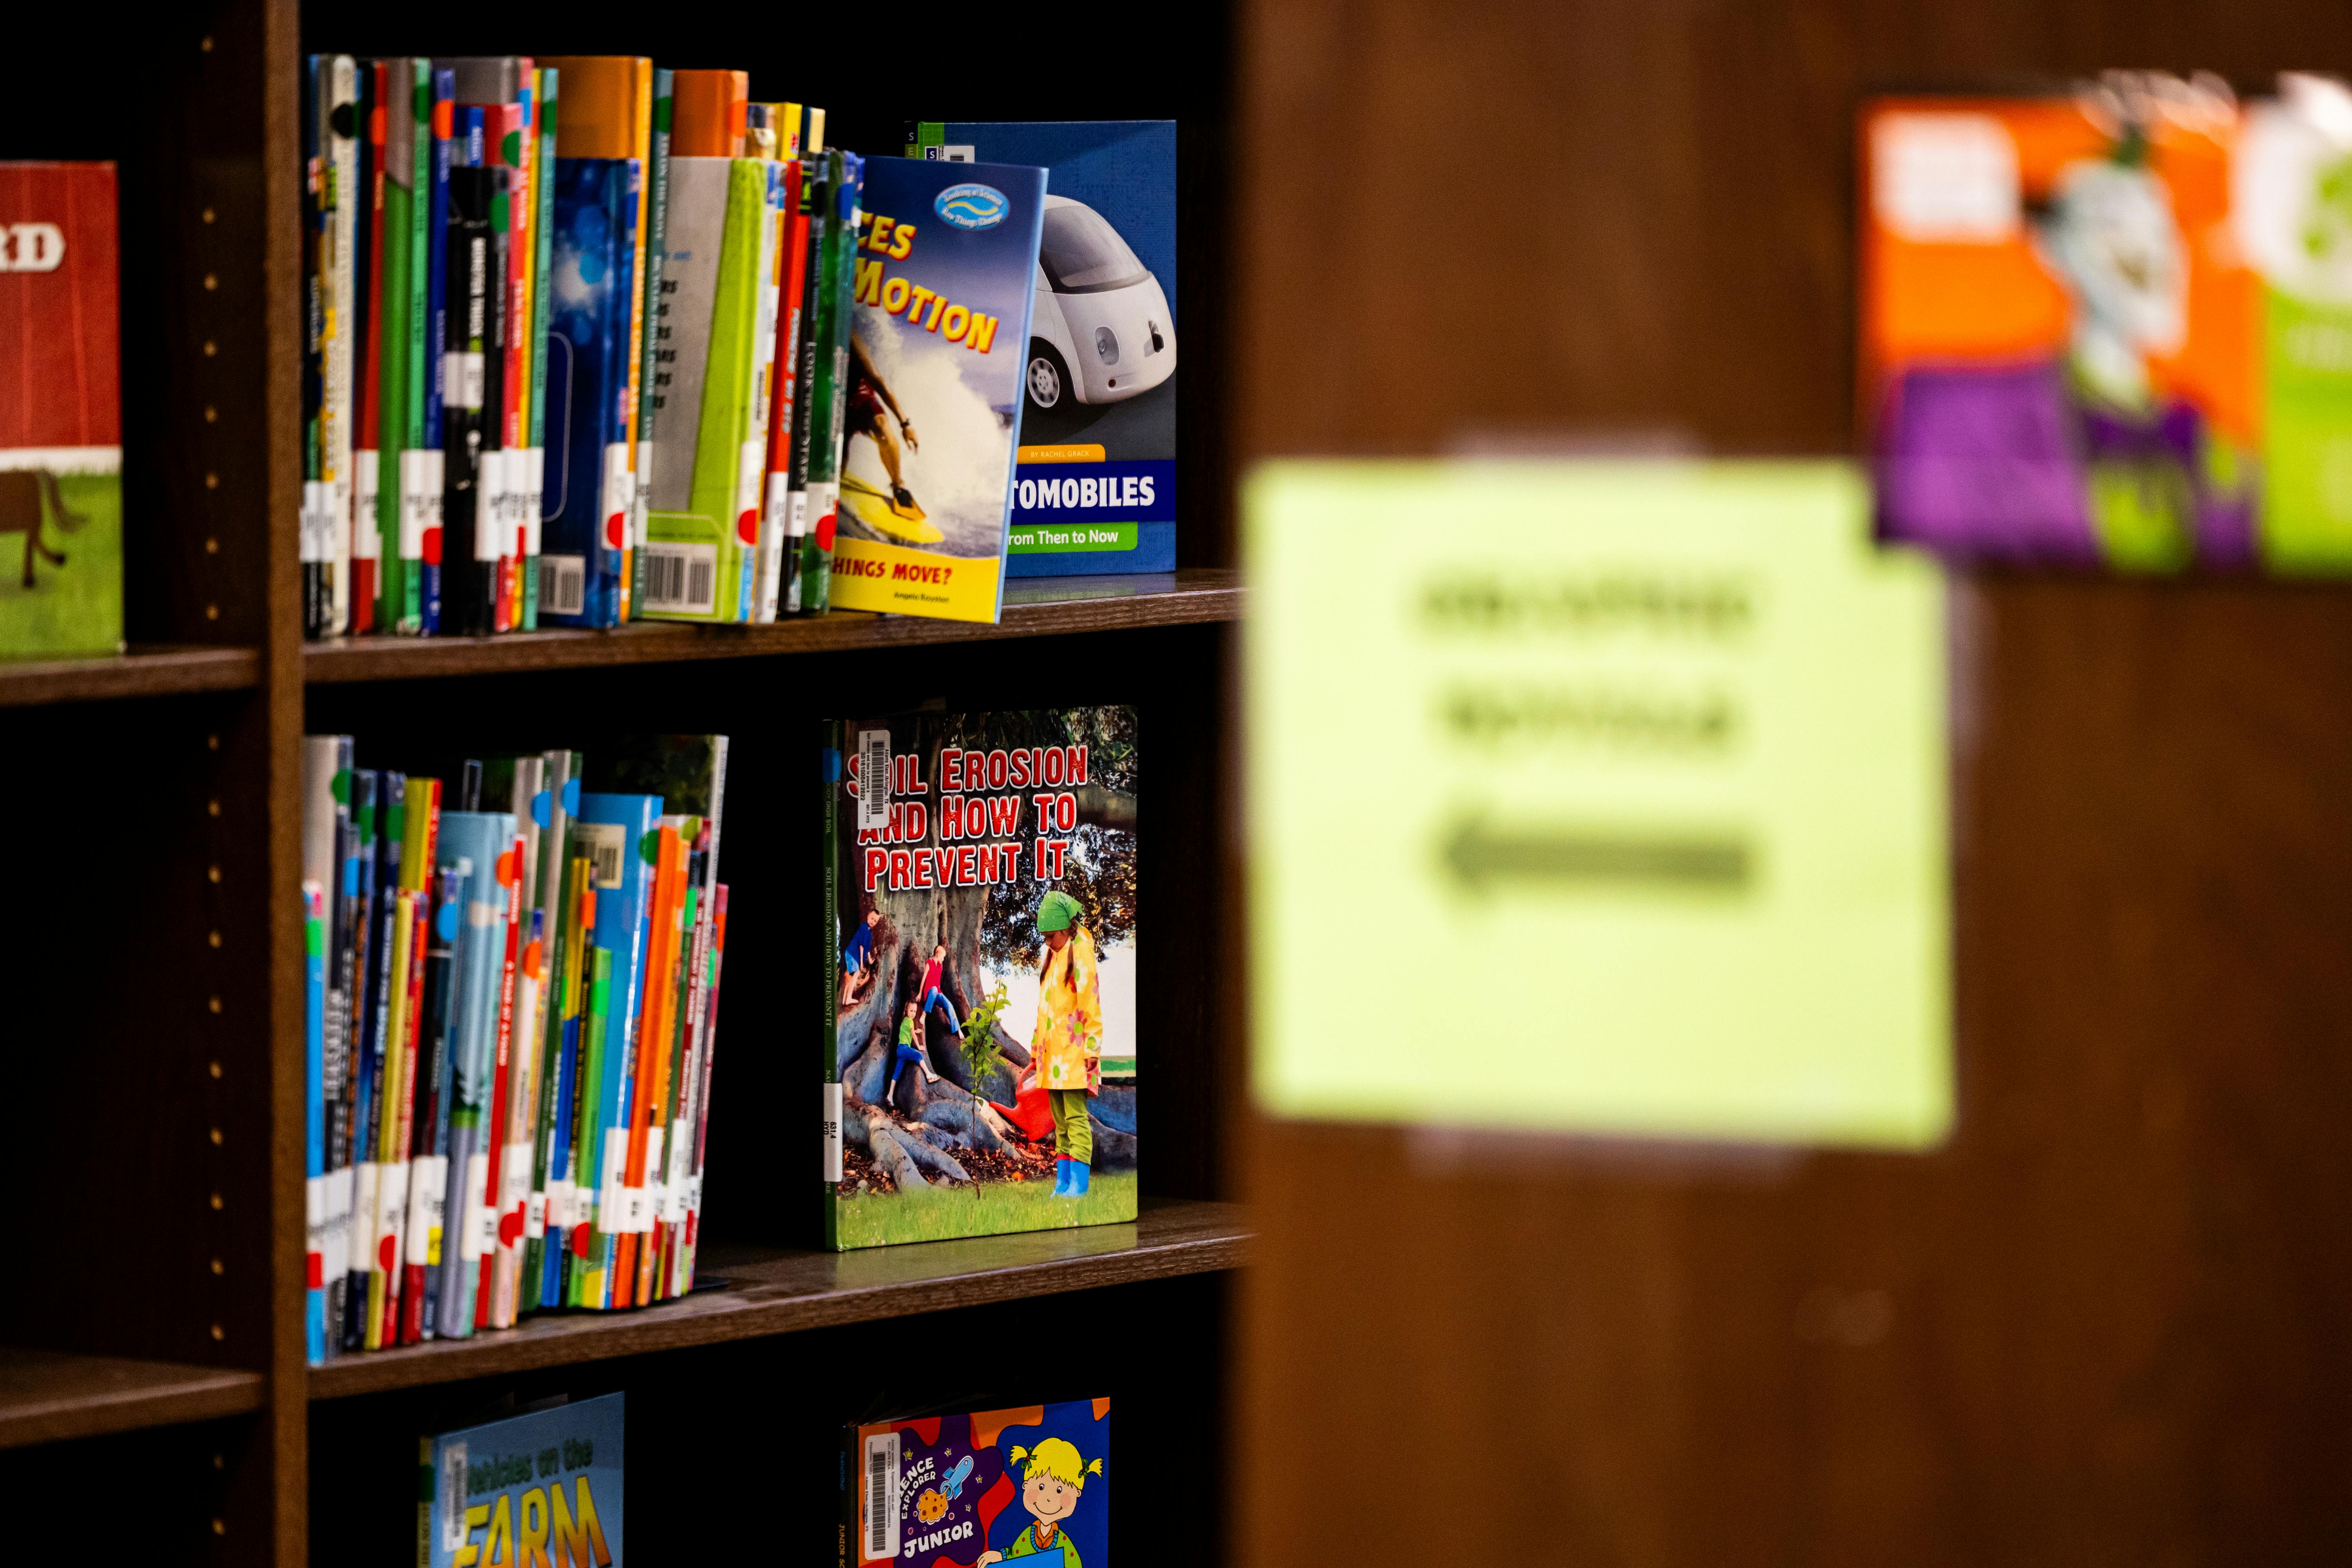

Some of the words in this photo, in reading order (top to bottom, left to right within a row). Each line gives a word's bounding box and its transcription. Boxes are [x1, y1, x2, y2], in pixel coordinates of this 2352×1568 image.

[908, 132, 914, 141] S
[929, 151, 935, 159] S
[855, 257, 998, 354] MOTION
[1008, 534, 1034, 545] rom
[1037, 531, 1069, 544] Then
[1072, 531, 1086, 543] to
[1089, 529, 1119, 543] Now
[831, 557, 886, 578] HINGS
[891, 563, 953, 585] MOVE?
[940, 745, 1088, 793] EROSION
[940, 795, 1020, 840] HOW
[1033, 792, 1077, 835] TO
[865, 842, 1022, 893] PREVENT
[1034, 837, 1069, 882] IT
[826, 967, 832, 978] TO
[826, 1019, 832, 1027] IT
[901, 1467, 936, 1520] EXPLORER
[452, 1475, 612, 1568] FARM
[904, 1521, 974, 1558] JUNIOR
